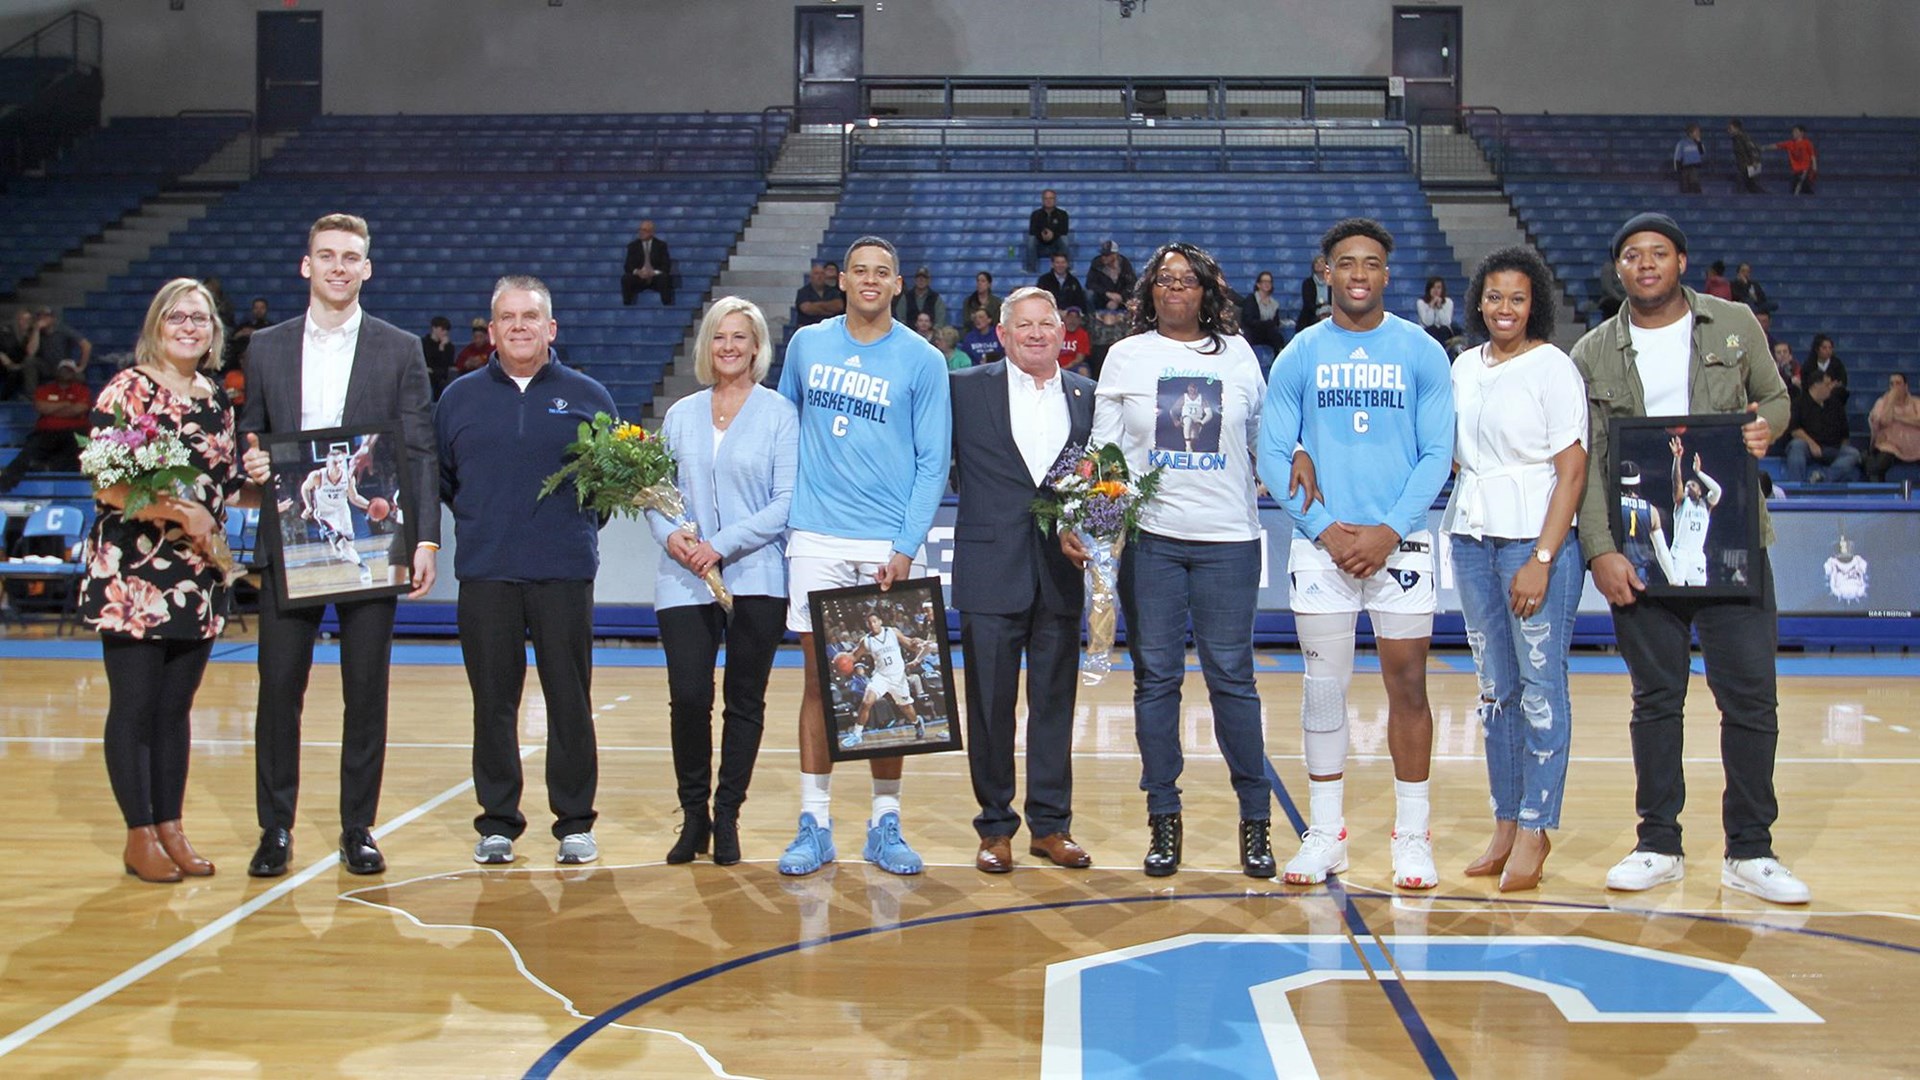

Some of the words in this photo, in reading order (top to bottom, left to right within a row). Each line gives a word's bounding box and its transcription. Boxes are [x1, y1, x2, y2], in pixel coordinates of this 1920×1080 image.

[808, 363, 891, 406] CITADEL
[1316, 363, 1406, 390] CITADEL
[808, 389, 886, 424] BASKETBALL
[1317, 389, 1405, 409] BASKETBALL
[832, 415, 850, 437] C
[1353, 411, 1369, 433] C
[1148, 449, 1226, 471] KAELON
[46, 508, 64, 531] C
[1690, 521, 1702, 531] 23
[1400, 569, 1412, 587] C
[883, 656, 893, 667] 13
